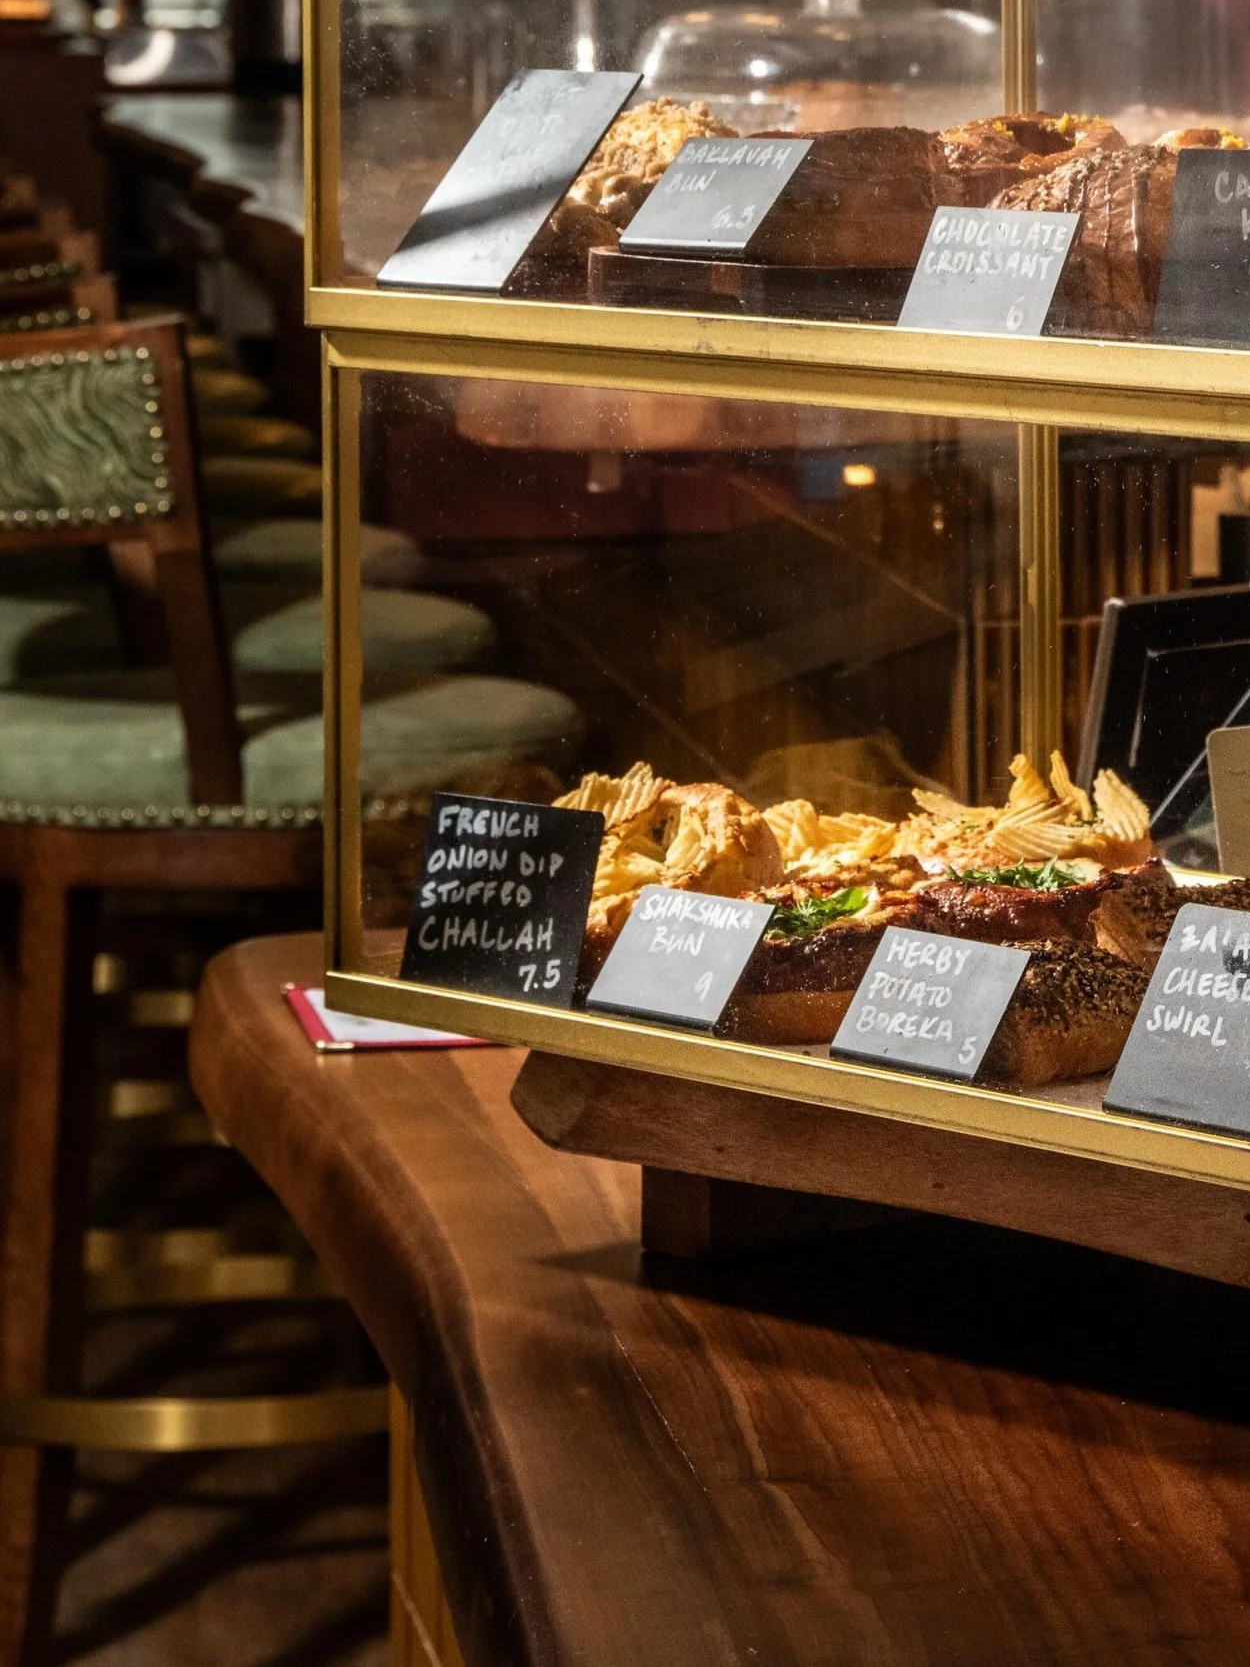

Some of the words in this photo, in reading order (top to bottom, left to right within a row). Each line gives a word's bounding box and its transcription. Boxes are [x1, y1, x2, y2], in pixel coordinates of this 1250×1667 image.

[677, 142, 792, 170] BAKLAVAH
[664, 170, 717, 195] BUN
[711, 205, 757, 230] 6.5
[931, 216, 1069, 254] CHOCOLATE
[923, 249, 1054, 281] CROISSANT
[1006, 295, 1026, 332] 6
[437, 804, 540, 838] FRENCH
[426, 844, 508, 874] ONION
[519, 851, 564, 878] DIP
[420, 879, 532, 908] STUFFED
[639, 894, 755, 931] SHAKSHUKA
[418, 915, 554, 952] CHALLAH
[649, 925, 706, 957] BUN
[886, 936, 972, 976] HERBY
[518, 958, 562, 993] 7.5
[868, 971, 952, 1008] POTATO
[856, 1005, 953, 1042] BOREKA
[1146, 1005, 1227, 1047] SWIRL
[957, 1035, 978, 1065] 5
